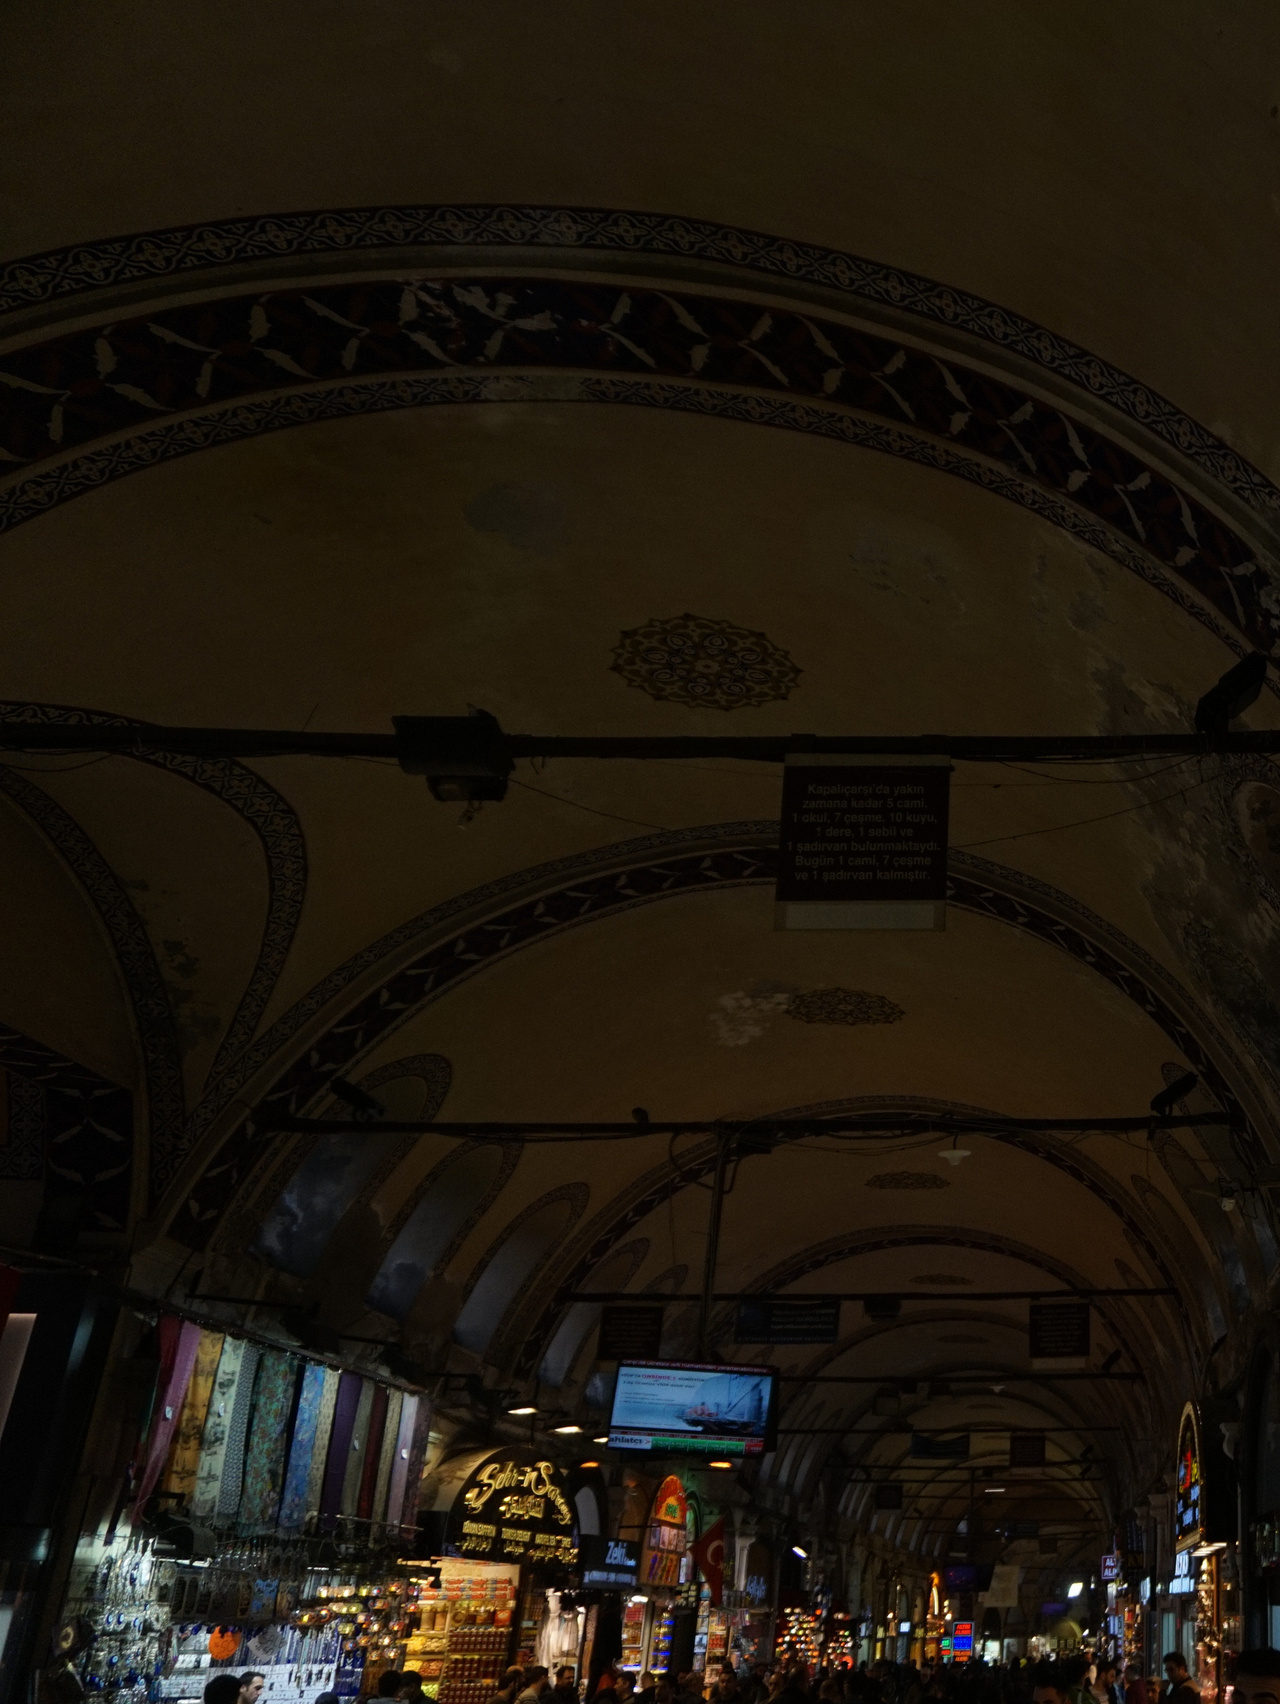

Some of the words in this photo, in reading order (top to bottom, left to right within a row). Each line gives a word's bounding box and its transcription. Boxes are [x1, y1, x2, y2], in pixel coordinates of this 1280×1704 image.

[802, 800, 848, 809] zamana
[850, 798, 884, 808] kadar
[834, 812, 841, 822] 7
[900, 829, 913, 837] ve
[883, 855, 890, 865] 7
[794, 872, 808, 880] ve
